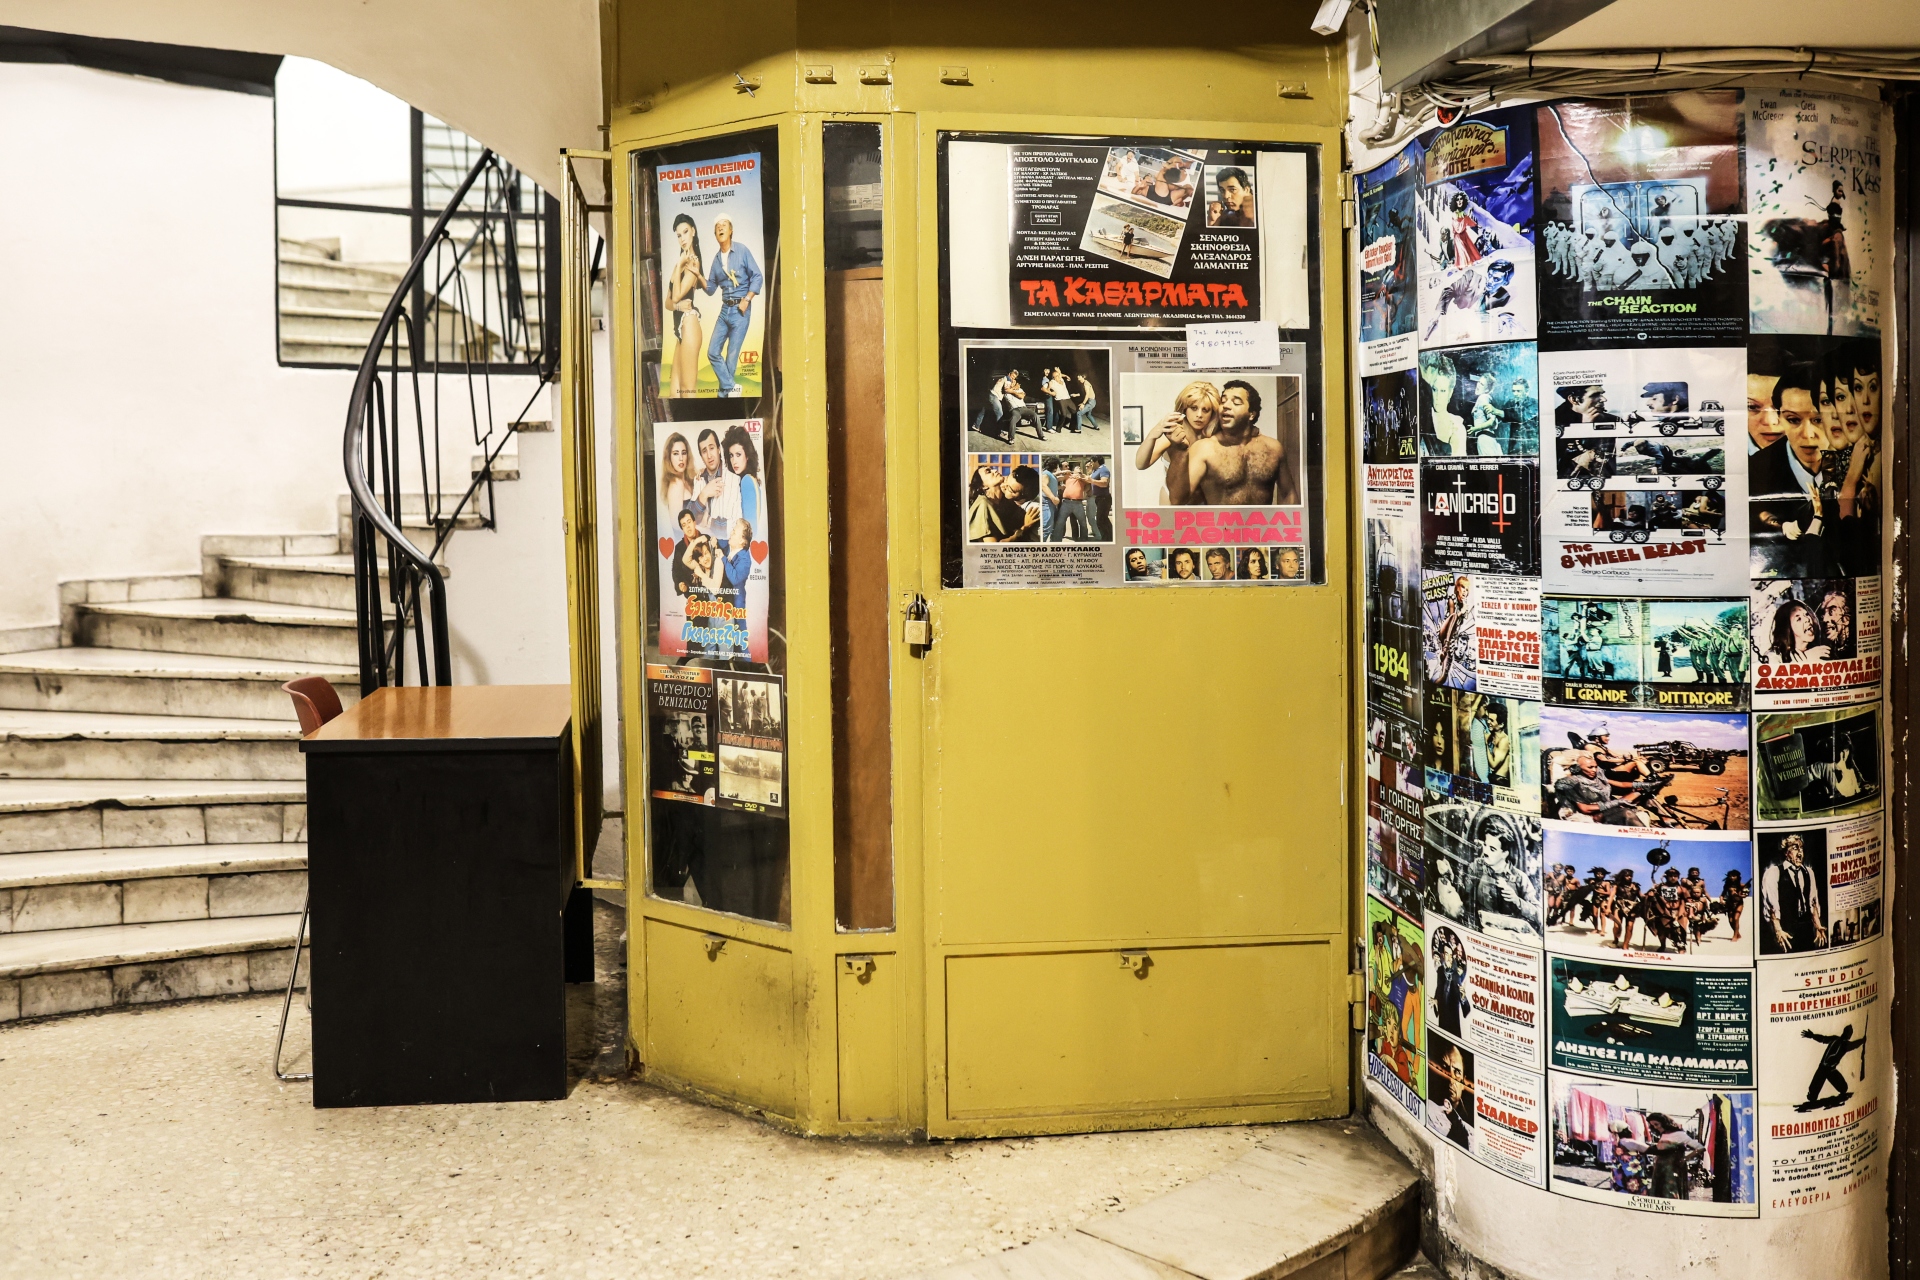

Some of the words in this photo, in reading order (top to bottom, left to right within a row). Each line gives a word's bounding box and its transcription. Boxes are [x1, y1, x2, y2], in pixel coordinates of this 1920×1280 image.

[1760, 99, 1777, 109] Ewan
[1801, 100, 1816, 111] Greta
[1752, 111, 1784, 121] McGregor
[659, 169, 692, 182] ΡΟΔΑ
[695, 159, 755, 177] ΜΠΛΕΞΙΜΟ
[1443, 158, 1474, 177] HOTEL
[672, 182, 693, 194] ΚΑΙ
[696, 175, 742, 190] ΤΡΕΛΛΑ
[1200, 234, 1239, 242] ΣΕΝΑΡΙΟ
[1190, 244, 1251, 252] ΣΚΗΝΟΘΕΣΙΑ
[1190, 253, 1252, 261] ΑΛΕΞΑΝΔΡΟΣ
[1020, 279, 1060, 308] ΤΑ
[1064, 276, 1249, 309] ΚΑΘΑΡΜΑΤΑ
[1603, 296, 1652, 305] CHAIN
[1619, 304, 1697, 314] REACTION
[1367, 465, 1414, 480] ΑΝΤΙΧΡΙΣΤΟΣ
[1125, 511, 1161, 529] ΤΟ
[1175, 511, 1301, 531] ΡΕΜΑΛΙ
[1125, 529, 1176, 546] ΤΗΣ
[1179, 528, 1303, 545] ΑΘΗΝΑΣ
[1560, 548, 1641, 569] 8-WHEEL
[1642, 539, 1707, 560] BEAST
[1563, 544, 1593, 554] The
[1422, 573, 1454, 589] BREAKING
[1426, 587, 1447, 600] GLASS
[732, 607, 747, 619] και
[1476, 627, 1541, 642] ΠΑΝΚ-ΡΟΚ:
[1478, 639, 1521, 652] ΣΠΑΣΤΕ
[1523, 643, 1540, 653] ΤΙΣ
[1373, 642, 1409, 682] 1984
[1478, 649, 1540, 664] ΒΙΤΡΙΝΕΣ
[1758, 665, 1772, 678] Ο
[1775, 660, 1863, 677] ΔΡΑΚΟΥΛΑΣ
[1755, 677, 1820, 690] ΑΚΟΜΑ
[1821, 674, 1842, 687] ΣΤΟ
[653, 683, 712, 698] ΕΛΕΥΘΕΡΙΟΣ
[1565, 688, 1576, 700] IL
[1578, 688, 1628, 702] GRANDE
[1659, 691, 1733, 705] DITTATORE
[659, 696, 708, 710] ΒΕΝΙΖΕΛΟΣ
[1777, 766, 1805, 782] VERGINE
[1380, 785, 1385, 800] Η
[1388, 789, 1421, 819] ΓΟΗΤΕΙΑ
[1507, 796, 1521, 804] KAZAN
[1380, 805, 1393, 826] ΤΗΣ
[1395, 815, 1421, 841] ΟΡΓΗΣ
[1832, 863, 1838, 873] Η
[1841, 857, 1867, 872] ΝΥΧΤΑ
[1869, 851, 1881, 864] ΤΟΥ
[1830, 870, 1860, 885] ΜΕΓΑΛΟΥ
[1467, 955, 1490, 968] ΠΗΤΕΡ
[1493, 965, 1537, 982] ΣΕΛΛΕΡΣ
[1805, 967, 1864, 987] STUDIO
[1475, 974, 1506, 998] ΣΑΤΑΝΙΚΑ
[1507, 985, 1535, 1005] ΚΟΛΠΑ
[1472, 991, 1489, 1009] ΦΟΥ
[1491, 1000, 1535, 1024] ΜΑΝΤΣΟΥ
[1771, 993, 1851, 1013] ΑΠΗΓΟΡΕΥΜΕΝΗΣ
[1697, 1012, 1711, 1020] ΑΡΤ
[1803, 1012, 1826, 1021] ΘΕΛΟΥΝ
[1835, 1007, 1848, 1016] ΔΟΥΝ
[1555, 1041, 1618, 1061] ΛΗΣΤΕΣ
[1620, 1052, 1646, 1064] ΓΙΑ
[1648, 1054, 1749, 1071] ΚΛΑΜΜΑΤΑ
[1369, 1053, 1403, 1101] HOPELESSLY
[1406, 1088, 1421, 1120] LOST
[1476, 1096, 1539, 1134] ΣΤΑΛΚΕΡ
[1772, 1115, 1840, 1137] ΠΕΘΑΙΝΟΝΤΑΣ
[1843, 1111, 1855, 1125] ΣΤΗ
[1805, 1142, 1860, 1162] ΙΣΠΑΝΙΚΟΥ
[1632, 1195, 1671, 1206] GORILLAS
[1655, 1204, 1676, 1212] MIST
[1773, 1191, 1831, 1209] ΕΛΕΥΘΕΡΙΑ
